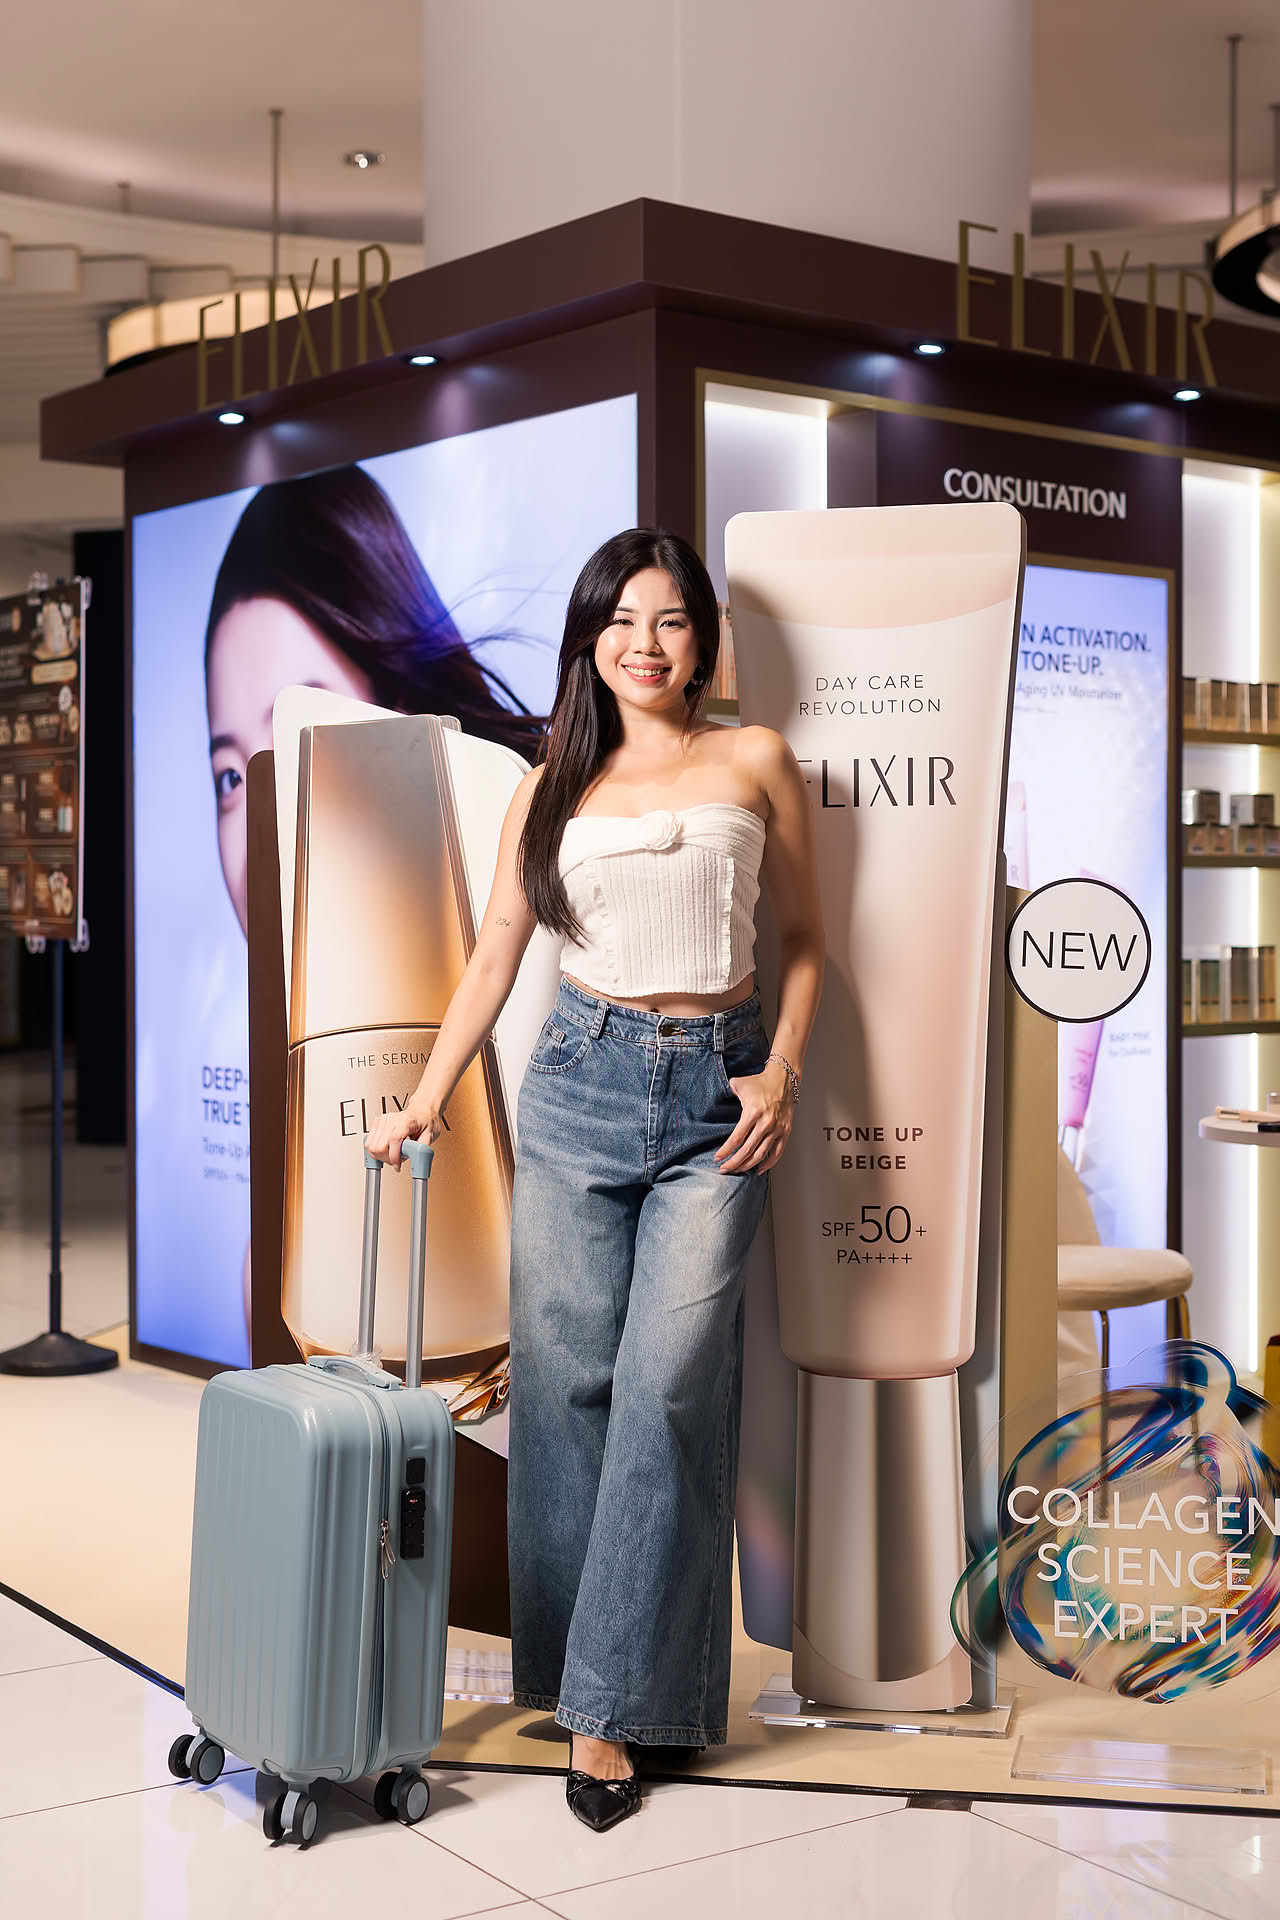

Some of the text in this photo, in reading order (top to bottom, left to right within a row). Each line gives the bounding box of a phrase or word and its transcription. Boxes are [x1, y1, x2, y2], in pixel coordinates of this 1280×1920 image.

[957, 219, 1218, 388] ELIXIR
[197, 243, 393, 412] ELIXIR
[943, 467, 1128, 520] CONSULTATION
[1040, 625, 1152, 653] ACTIVATION.
[1021, 650, 1104, 676] TONE-UP.
[815, 674, 924, 692] DAY CARE
[799, 697, 942, 716] REVOLUTION
[797, 754, 957, 809] LIXIR
[1021, 930, 1138, 972] NEW
[347, 1054, 376, 1069] THE
[202, 1098, 242, 1125] TRUE
[823, 1127, 924, 1142] TONE UP
[841, 1155, 907, 1170] BEIGE
[837, 1249, 913, 1265] PA++++
[1007, 1485, 1280, 1536] COLLAGEN
[1036, 1542, 1252, 1591] SCIENCE
[1053, 1599, 1239, 1646] EXPERT
